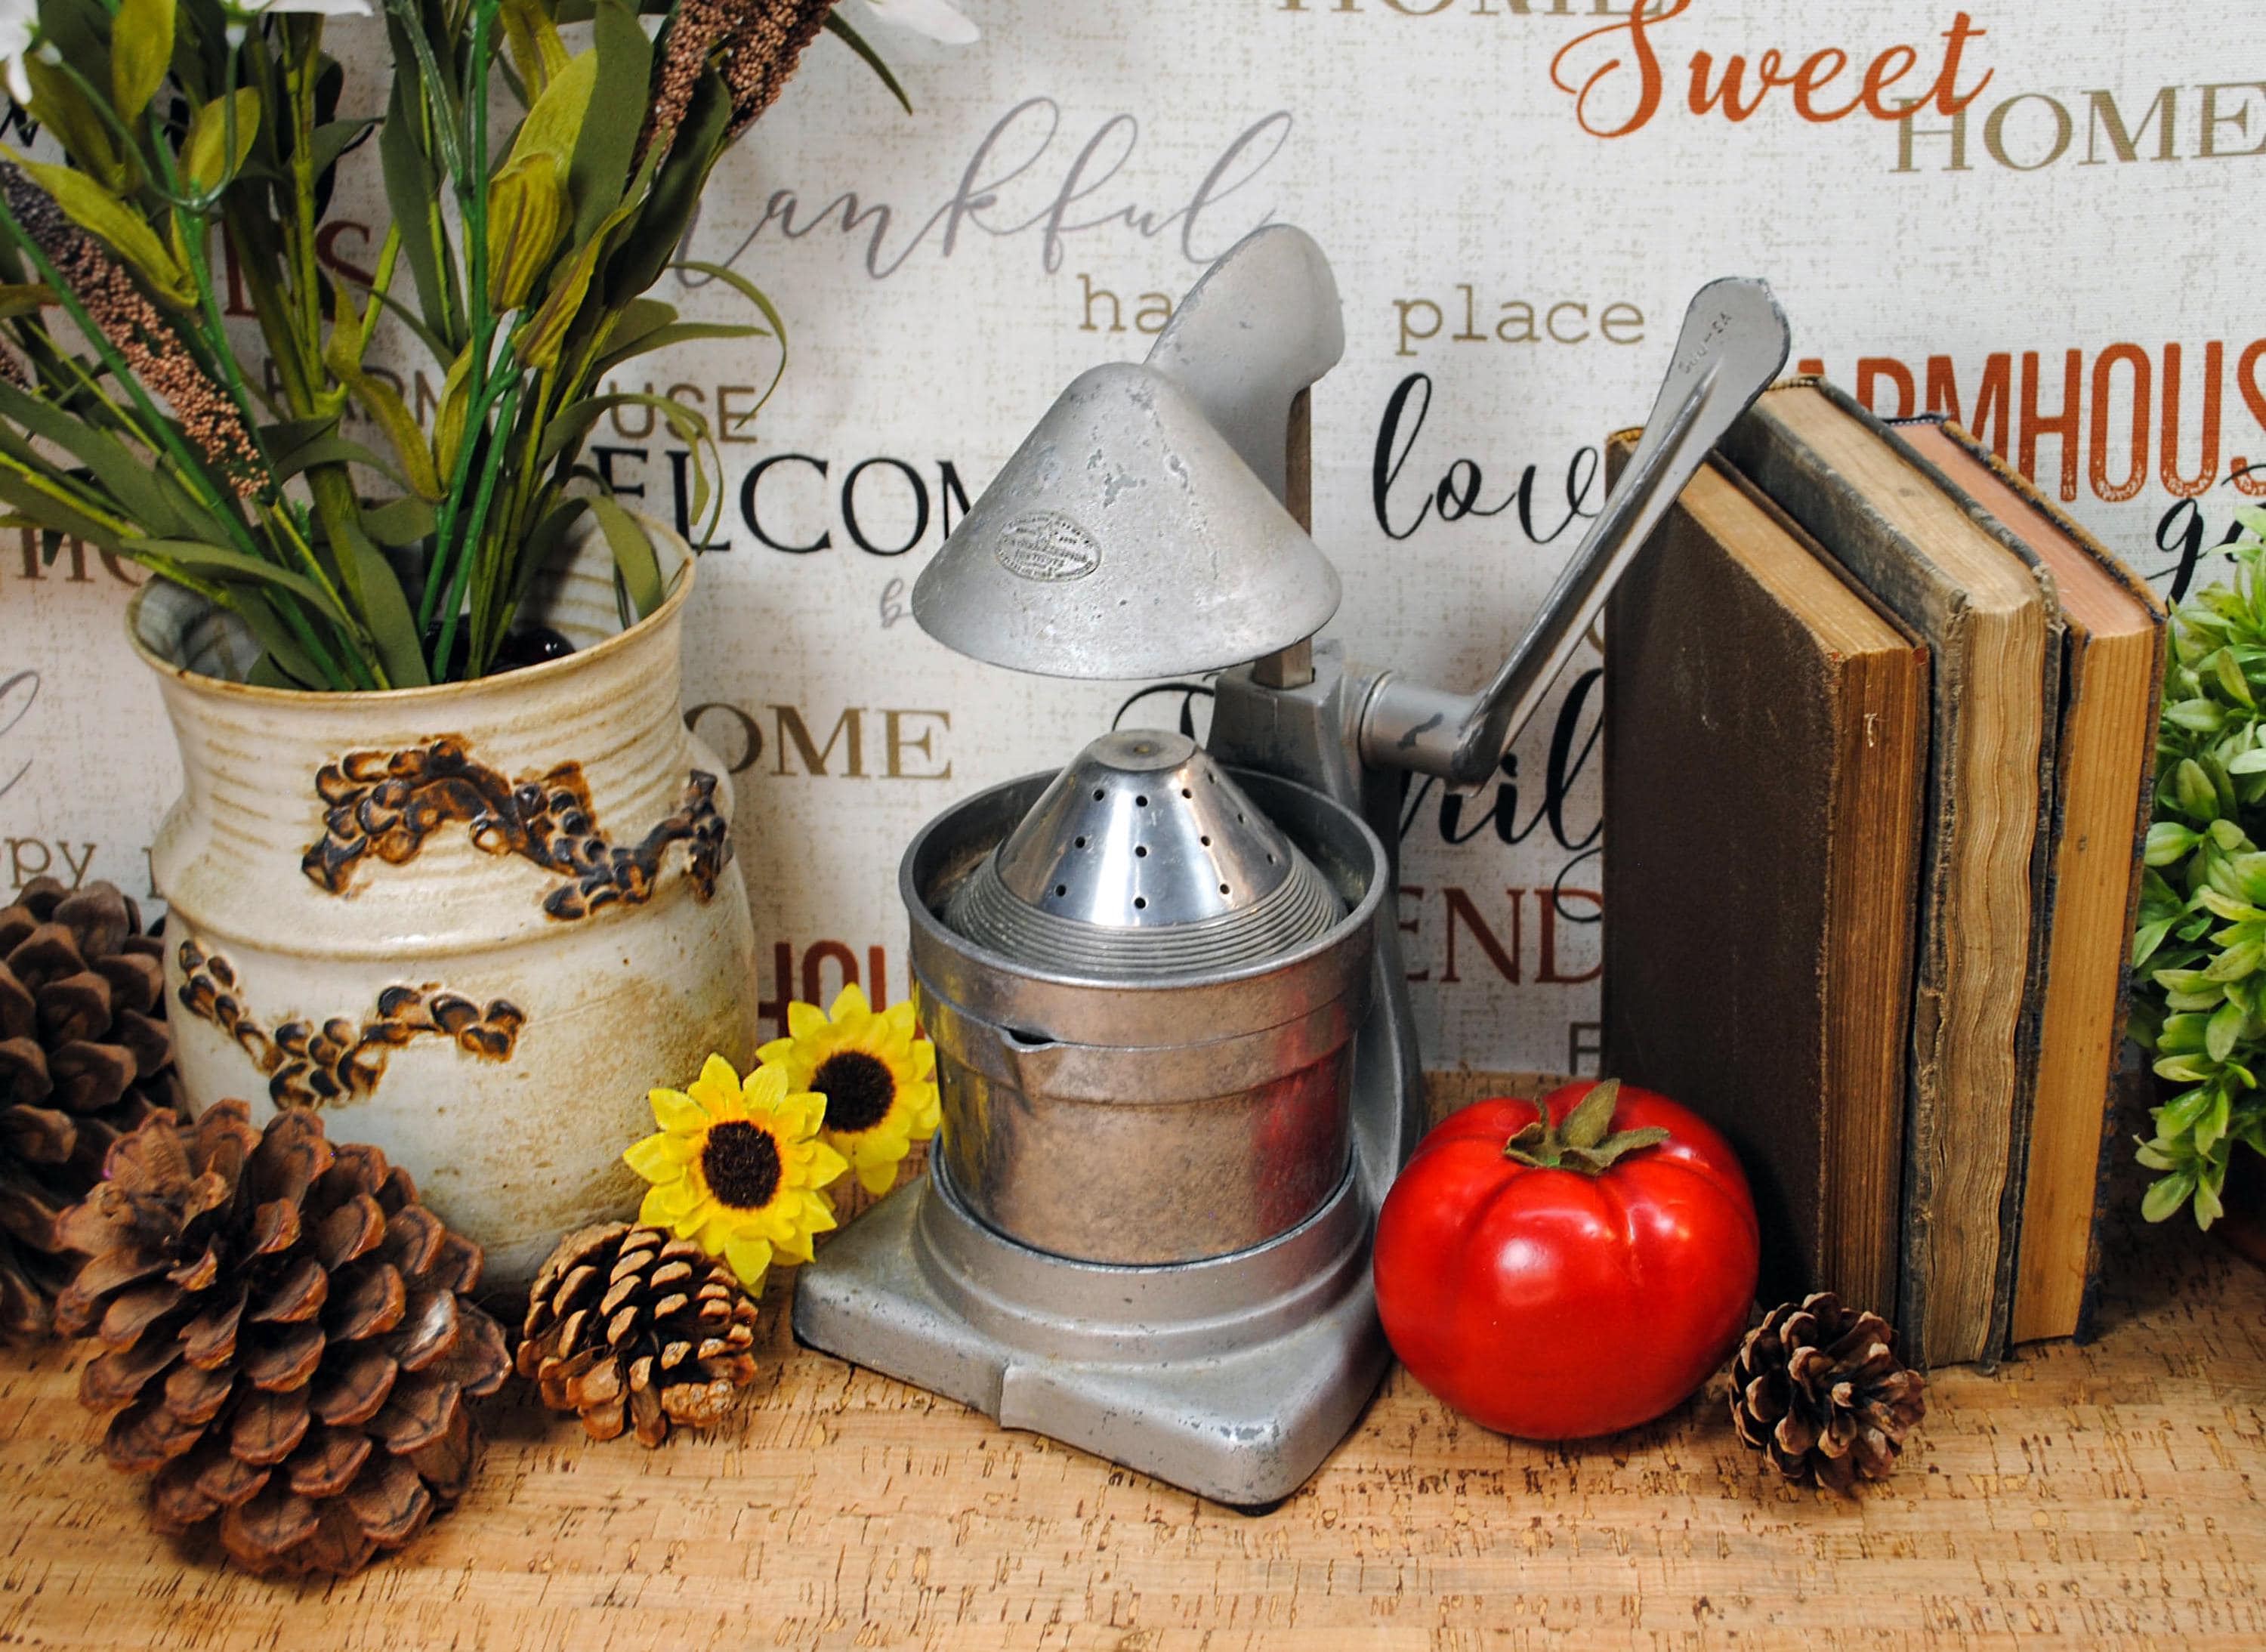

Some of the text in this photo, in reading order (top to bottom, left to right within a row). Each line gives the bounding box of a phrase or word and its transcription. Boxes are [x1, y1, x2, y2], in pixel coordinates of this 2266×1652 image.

[1551, 0, 1994, 139] Sweet
[1889, 81, 2266, 173] HOME
[675, 96, 1292, 289] ankful
[1393, 284, 1645, 356] place
[1373, 372, 1602, 545] love
[684, 702, 952, 781] OME
